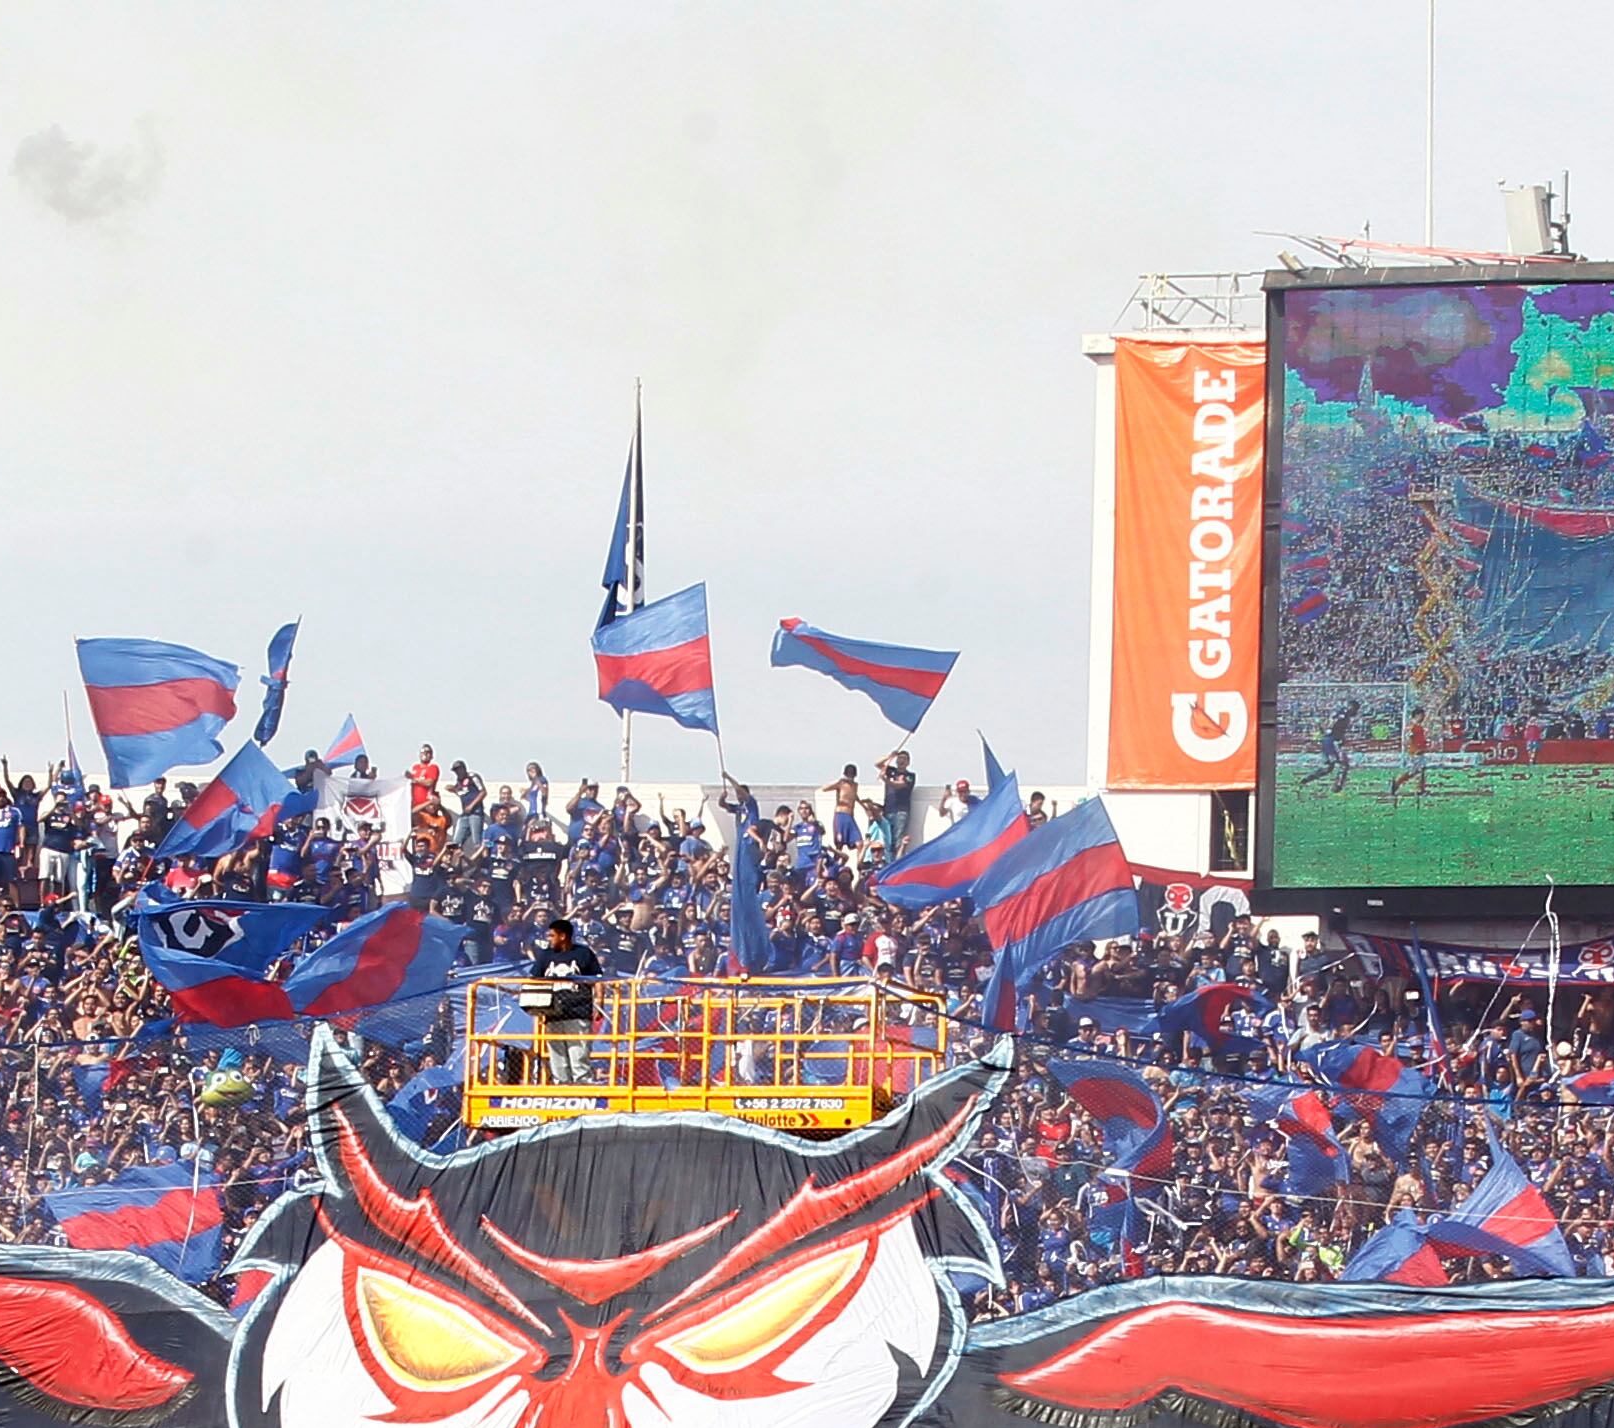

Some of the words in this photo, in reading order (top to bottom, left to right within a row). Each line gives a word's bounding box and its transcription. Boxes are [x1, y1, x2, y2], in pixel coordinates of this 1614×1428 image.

[1189, 368, 1237, 681] GATORADE
[500, 1098, 597, 1110] HORIZON
[745, 1099, 766, 1111] +56
[769, 1099, 777, 1111] 2
[780, 1099, 811, 1111] 2372
[738, 1113, 795, 1127] Haulotte
